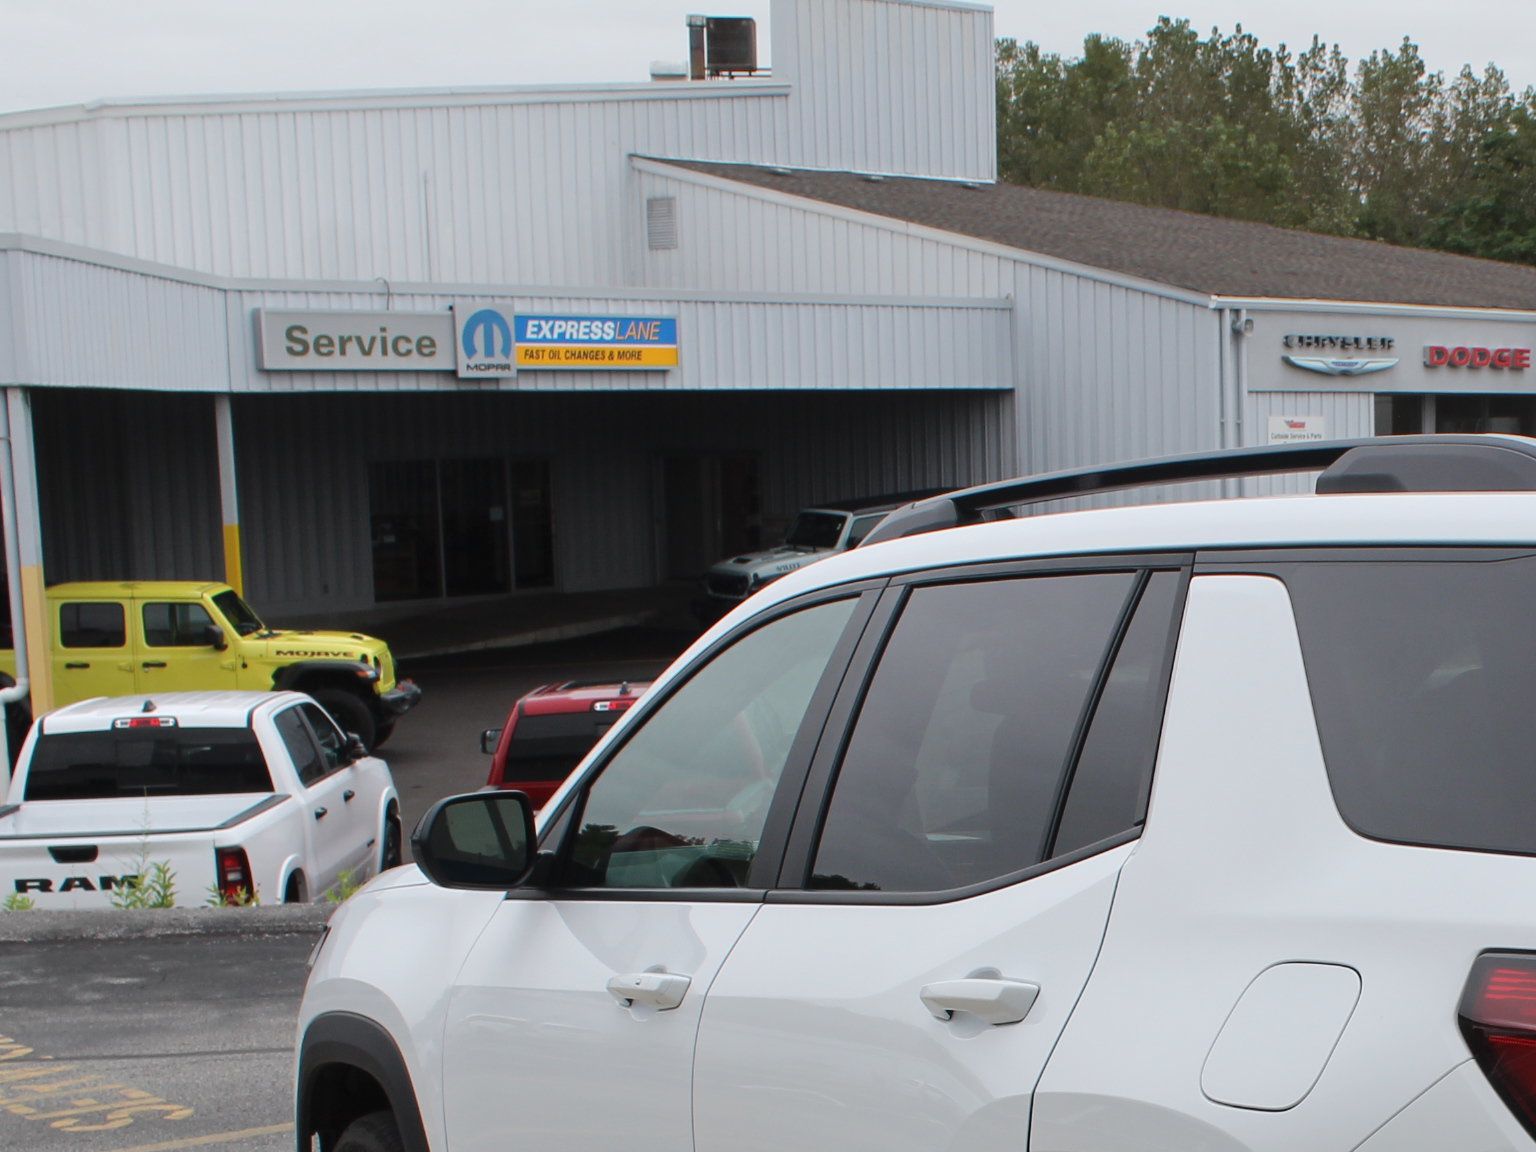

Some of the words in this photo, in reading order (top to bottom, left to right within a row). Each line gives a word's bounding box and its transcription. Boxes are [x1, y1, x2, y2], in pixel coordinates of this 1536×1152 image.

[284, 325, 437, 358] Service
[1283, 335, 1395, 350] CHRYSLER
[524, 349, 545, 361] FAST
[548, 350, 562, 361] OIL
[564, 350, 607, 361] CHANGES
[608, 350, 615, 361] &
[616, 350, 643, 361] MORE
[1424, 346, 1531, 369] DODGE
[466, 363, 511, 372] MOPAR
[276, 649, 355, 658] MOJAVE
[14, 875, 143, 894] RAM
